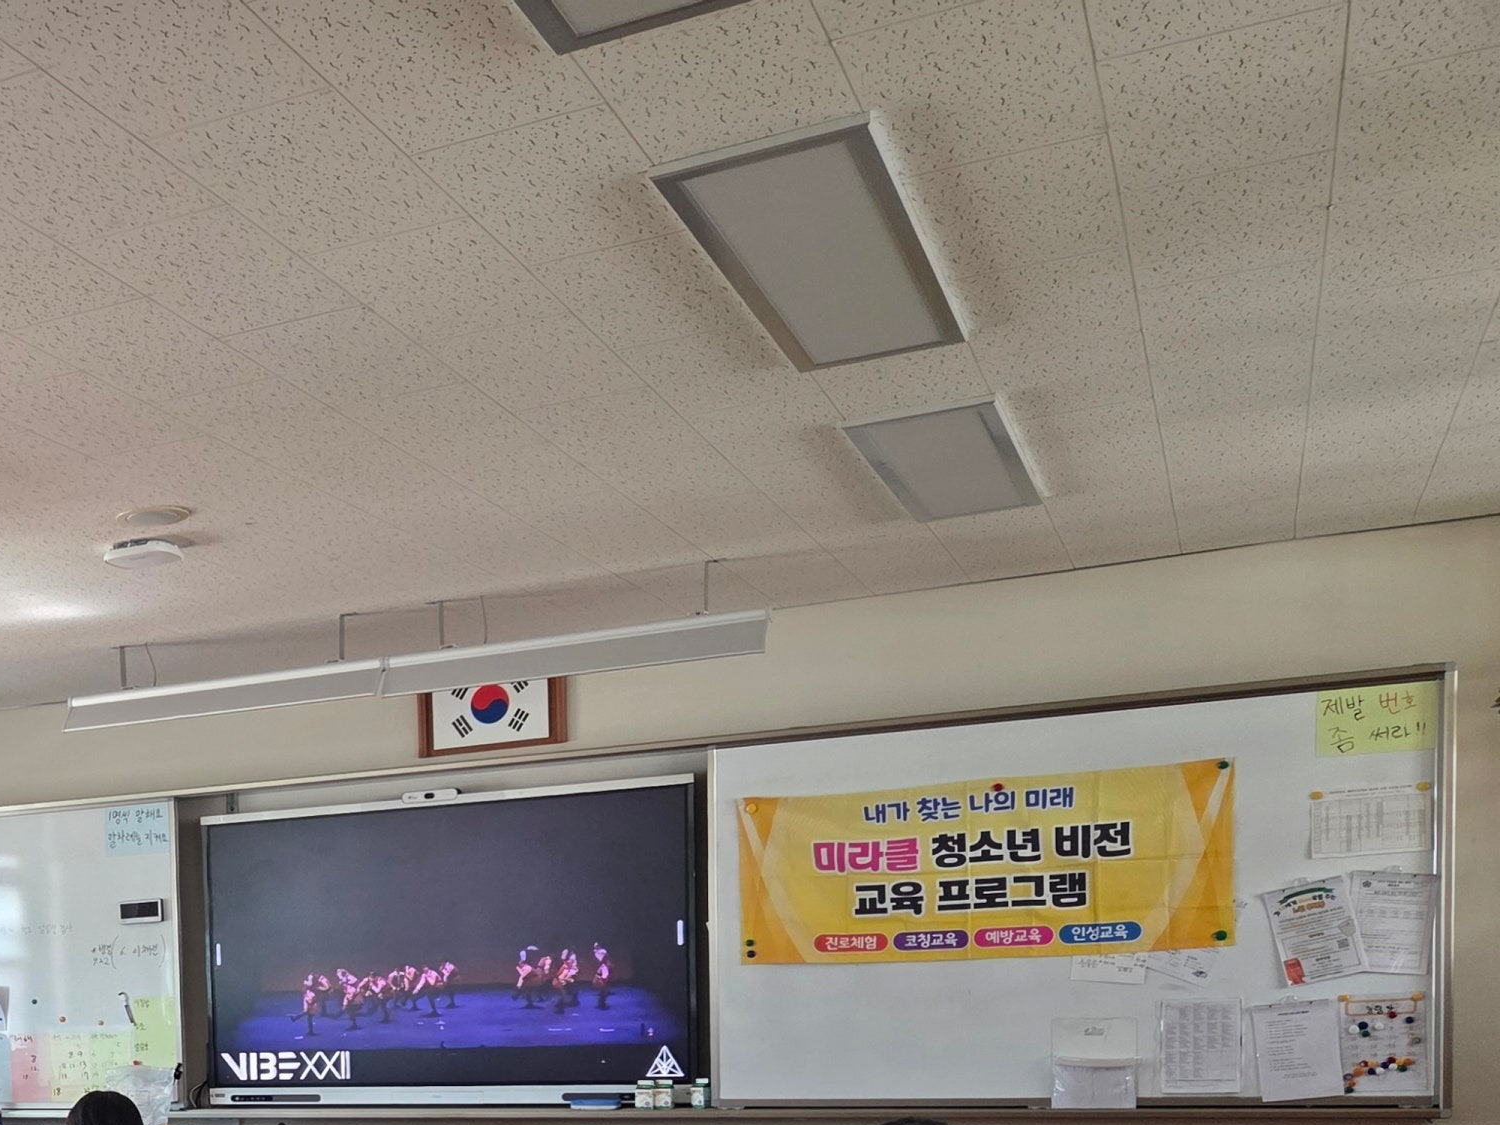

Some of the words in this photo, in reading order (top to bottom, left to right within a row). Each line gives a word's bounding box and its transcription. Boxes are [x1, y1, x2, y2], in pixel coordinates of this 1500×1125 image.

[1321, 694, 1365, 721] 제발
[1379, 690, 1416, 715] 번호
[1328, 727, 1354, 753] 좀
[864, 801, 910, 823] 내가
[917, 797, 961, 822] 찾는
[969, 791, 1015, 813] 나의
[1025, 787, 1074, 809] 미래
[813, 837, 919, 873] 미라클
[932, 828, 1042, 868] 청소년
[1055, 821, 1132, 859] 비전
[854, 881, 924, 915] 교육
[937, 872, 1087, 911] 프로그램
[825, 934, 878, 950] 진로체험
[904, 932, 957, 948] 코칭교육
[985, 928, 1042, 944] 예방교육
[1071, 924, 1129, 941] 인성교육
